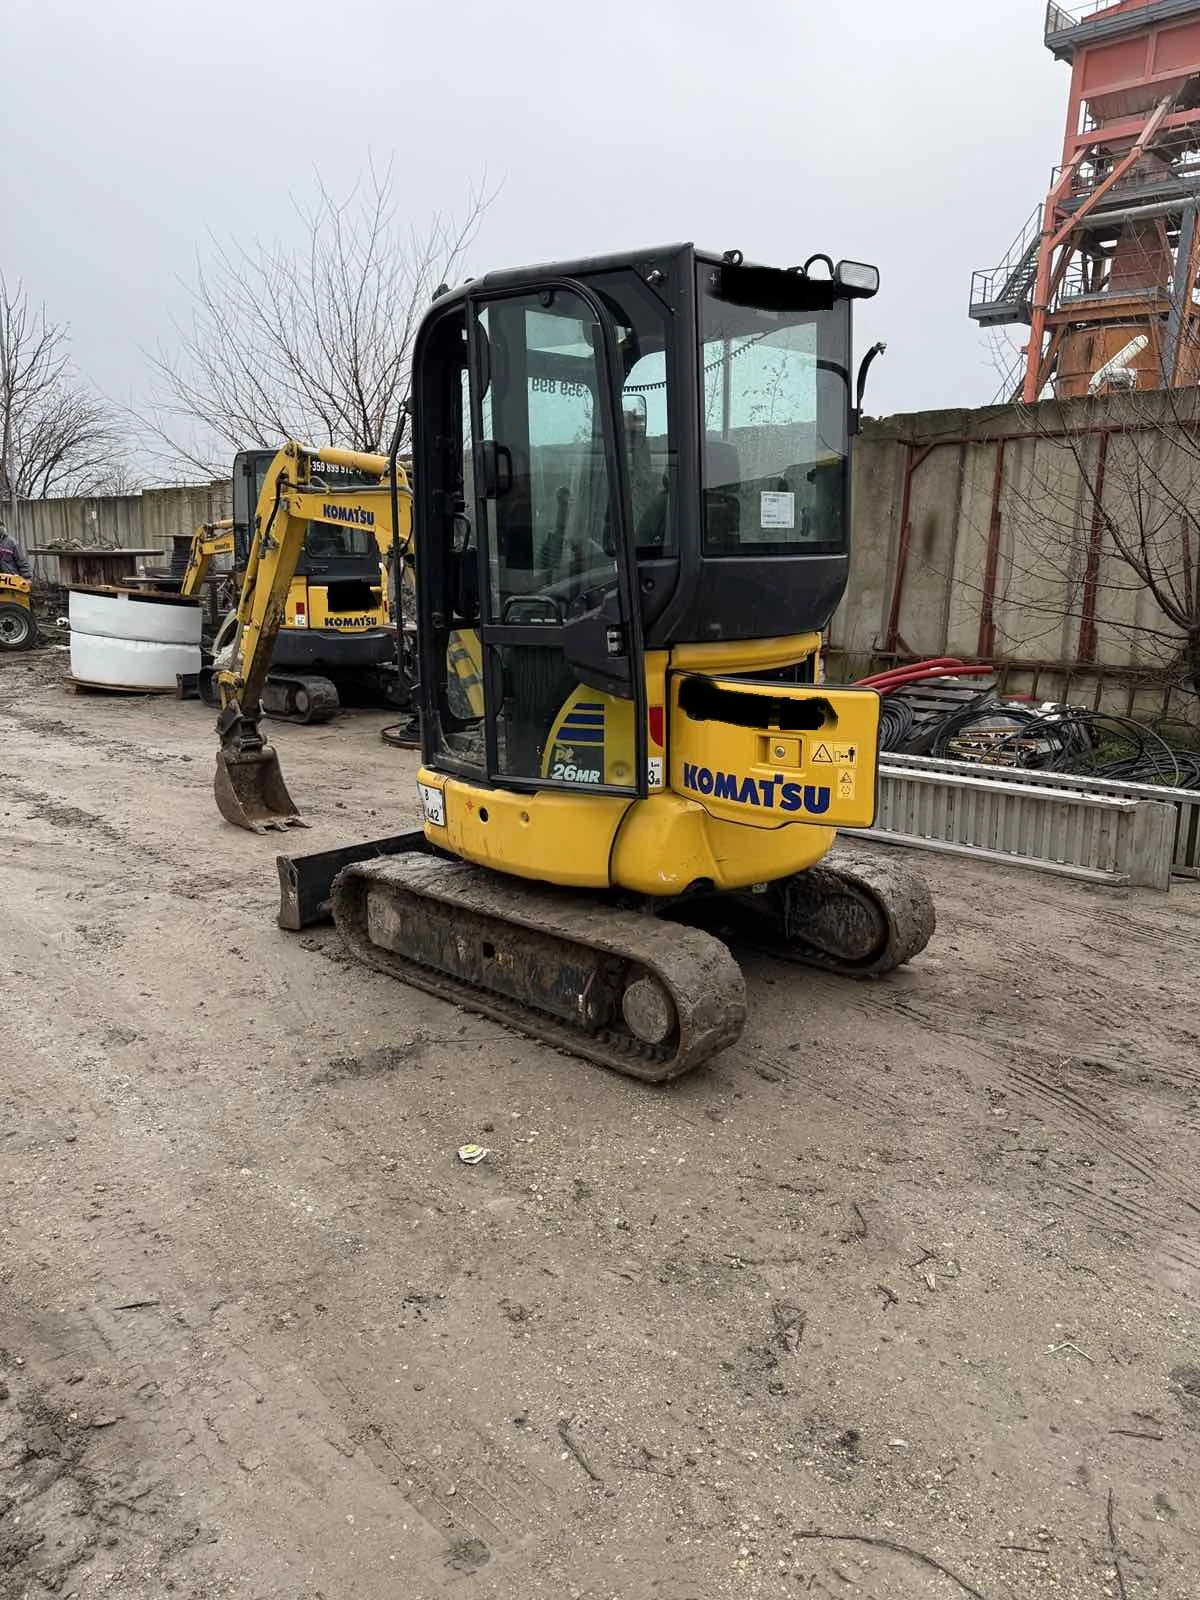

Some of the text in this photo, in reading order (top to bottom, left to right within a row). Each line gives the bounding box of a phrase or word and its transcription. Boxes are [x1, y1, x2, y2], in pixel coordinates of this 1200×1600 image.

[323, 503, 375, 525] KOMATSU
[324, 614, 377, 626] KOMATSU
[551, 763, 600, 784] 26MR
[683, 762, 831, 814] KOMATSU
